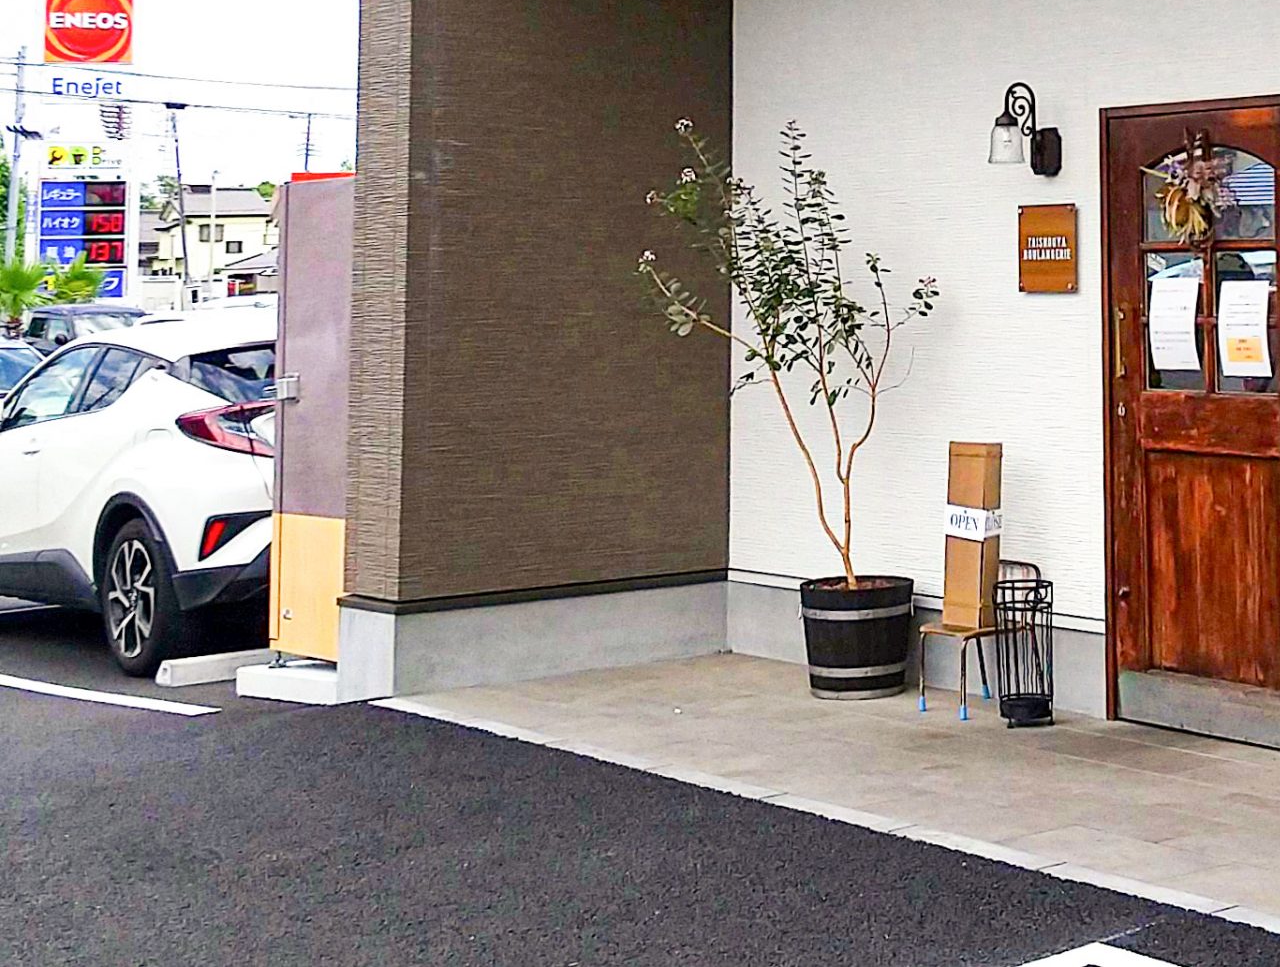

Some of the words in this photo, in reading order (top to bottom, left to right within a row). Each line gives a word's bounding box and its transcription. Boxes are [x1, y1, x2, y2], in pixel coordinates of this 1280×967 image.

[50, 12, 129, 29] ENEOS
[52, 77, 122, 98] Enejet
[42, 217, 81, 229] ハイオク
[92, 213, 124, 233] 158
[90, 241, 124, 261] 137
[950, 513, 979, 531] OPEN
